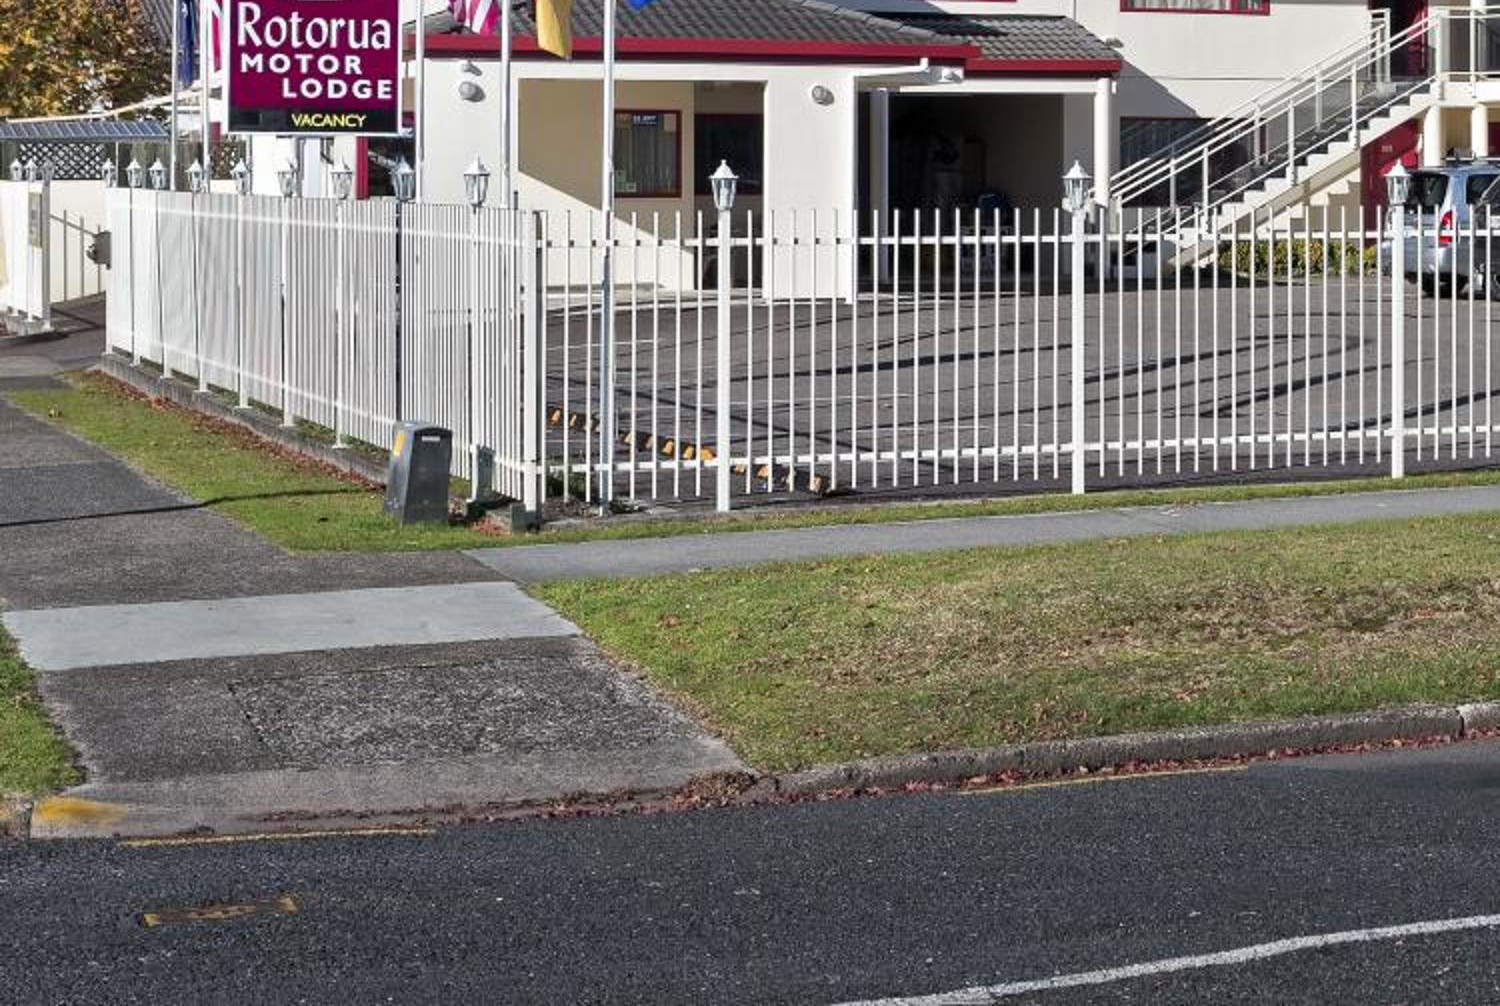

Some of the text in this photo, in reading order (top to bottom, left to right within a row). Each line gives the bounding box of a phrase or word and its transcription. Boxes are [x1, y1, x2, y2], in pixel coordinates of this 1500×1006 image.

[237, 1, 391, 49] Rotorua
[240, 53, 362, 75] MOTOR
[282, 78, 392, 99] LODGE
[291, 113, 367, 127] VACANCY
